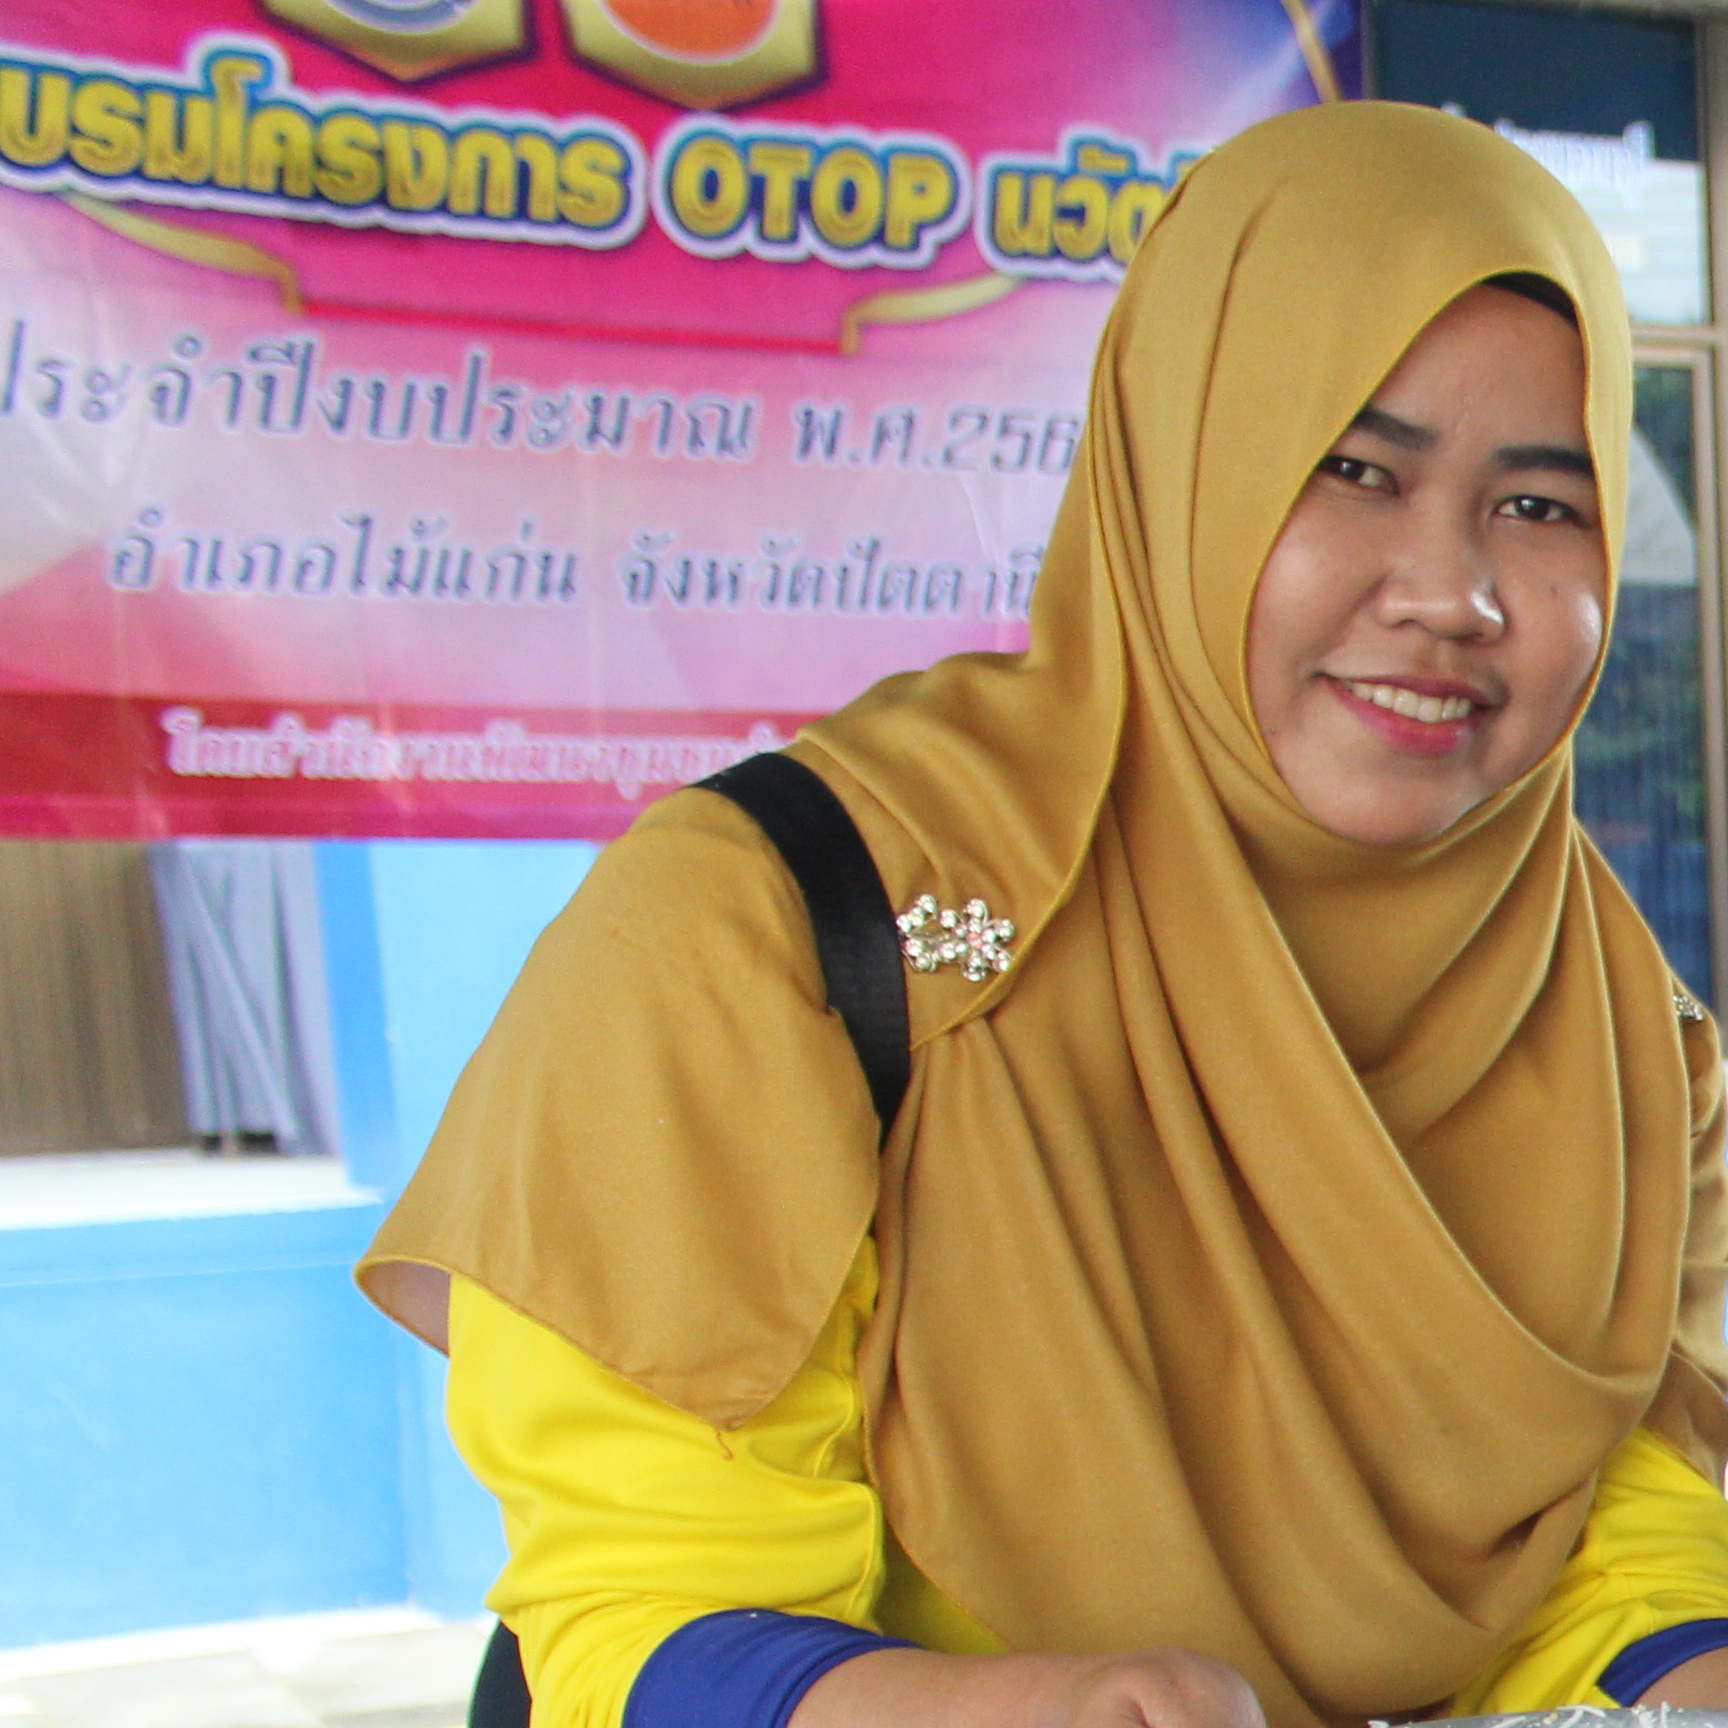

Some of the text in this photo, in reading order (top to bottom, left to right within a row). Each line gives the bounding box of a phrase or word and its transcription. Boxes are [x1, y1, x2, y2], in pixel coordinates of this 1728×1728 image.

[664, 130, 958, 258] OTOP
[990, 138, 1205, 265] นวัต
[795, 403, 1086, 476] พ.ศ.256
[111, 506, 579, 602] อำเภอไม้แก่น
